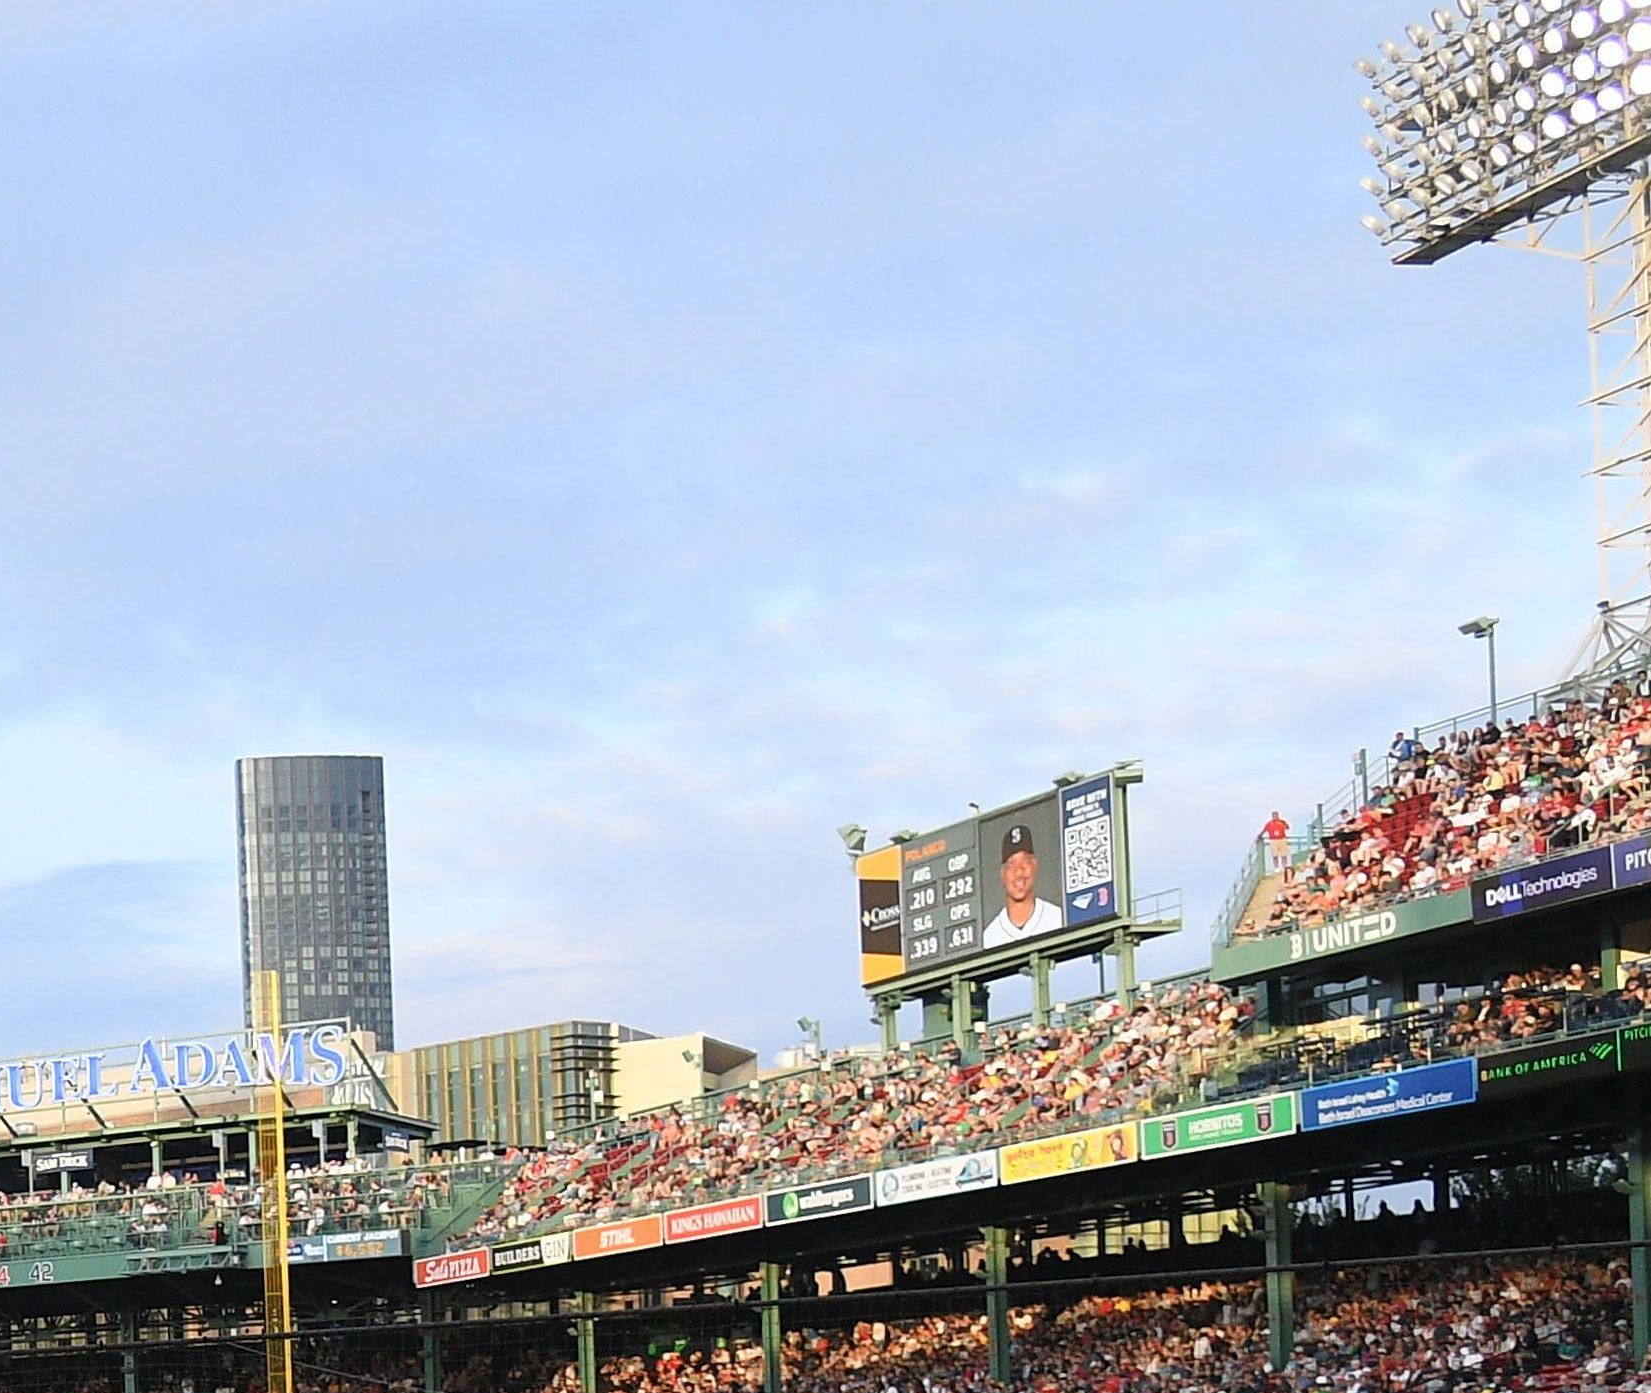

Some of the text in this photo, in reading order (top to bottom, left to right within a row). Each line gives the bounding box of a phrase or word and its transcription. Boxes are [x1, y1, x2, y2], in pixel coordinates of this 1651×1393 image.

[1485, 864, 1599, 907] DELL Technologies
[1312, 911, 1397, 952] UNITED
[131, 1023, 349, 1094] ADAMS
[494, 1237, 567, 1267] BUILDERS GIN
[599, 1228, 636, 1248] STIHL
[28, 1262, 55, 1283] 42
[448, 1256, 482, 1279] PIZZA
